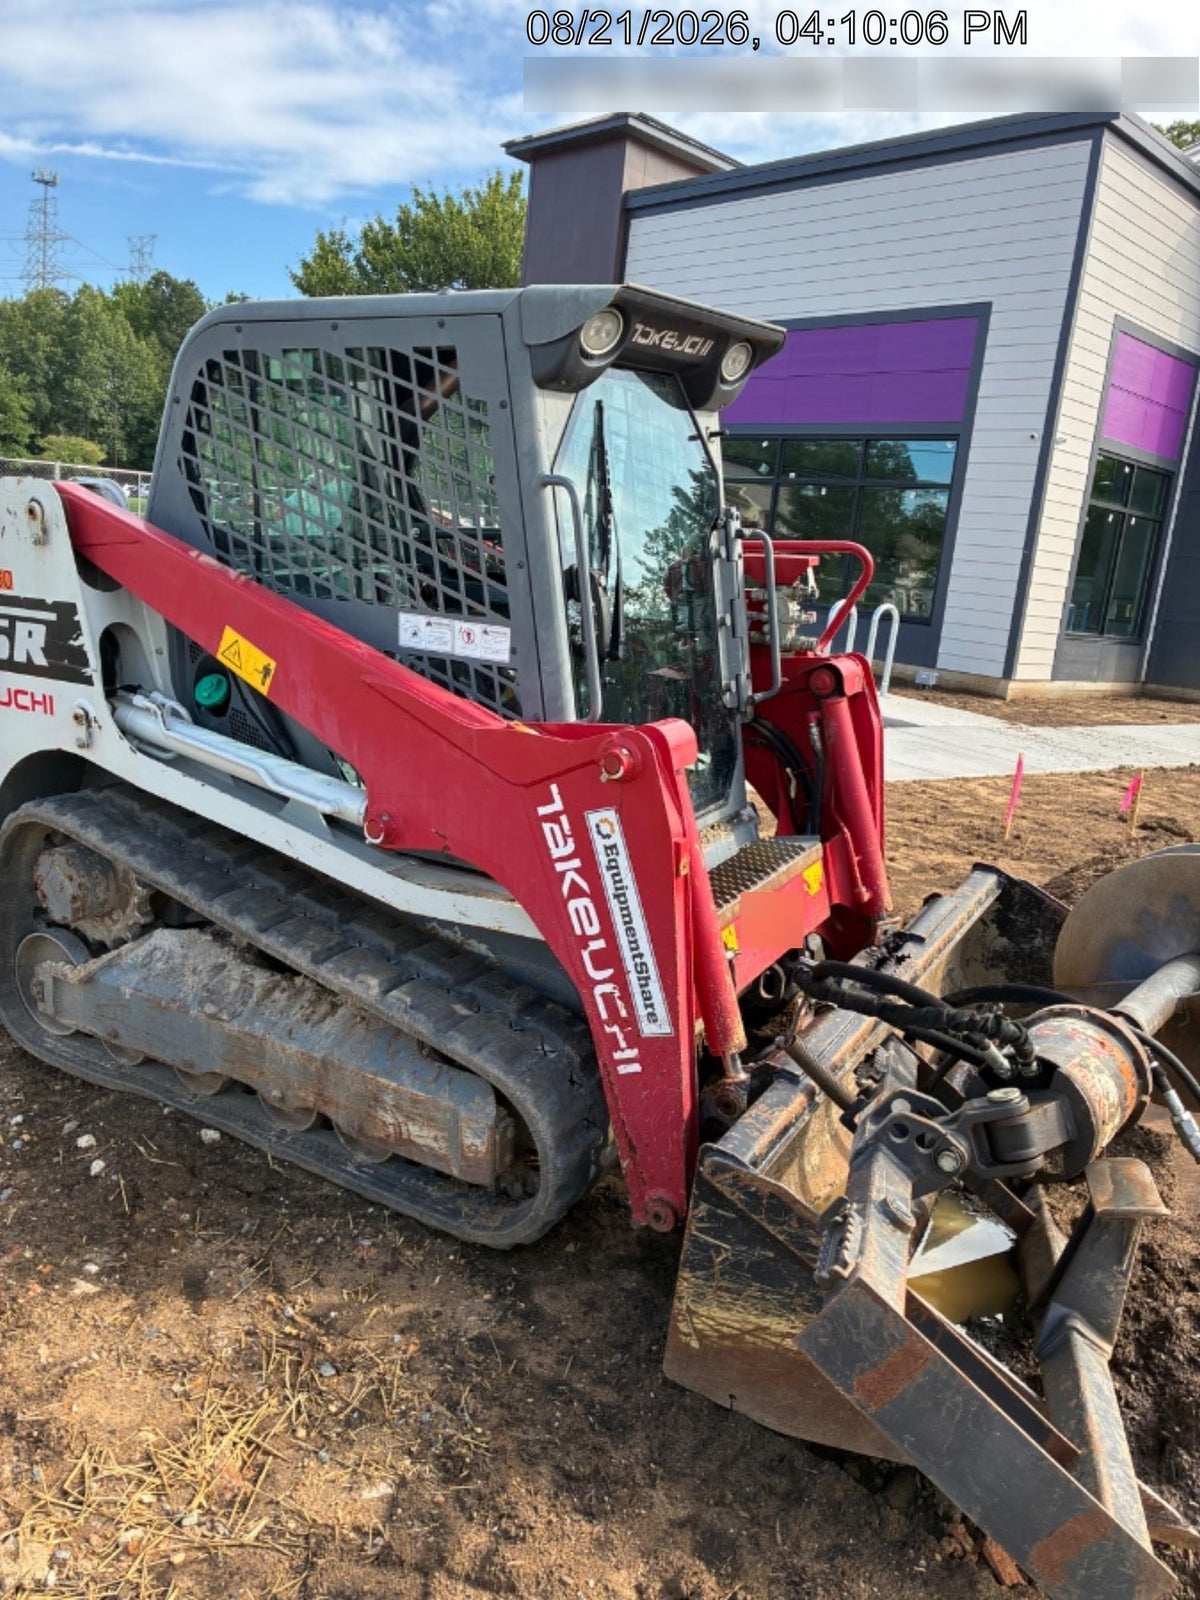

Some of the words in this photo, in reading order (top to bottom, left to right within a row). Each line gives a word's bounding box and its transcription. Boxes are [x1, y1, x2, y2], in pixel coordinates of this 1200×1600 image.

[632, 322, 714, 357] TAKEUCHI
[537, 783, 642, 1074] TAKEUCHI
[602, 842, 659, 1025] EquipmentShare
